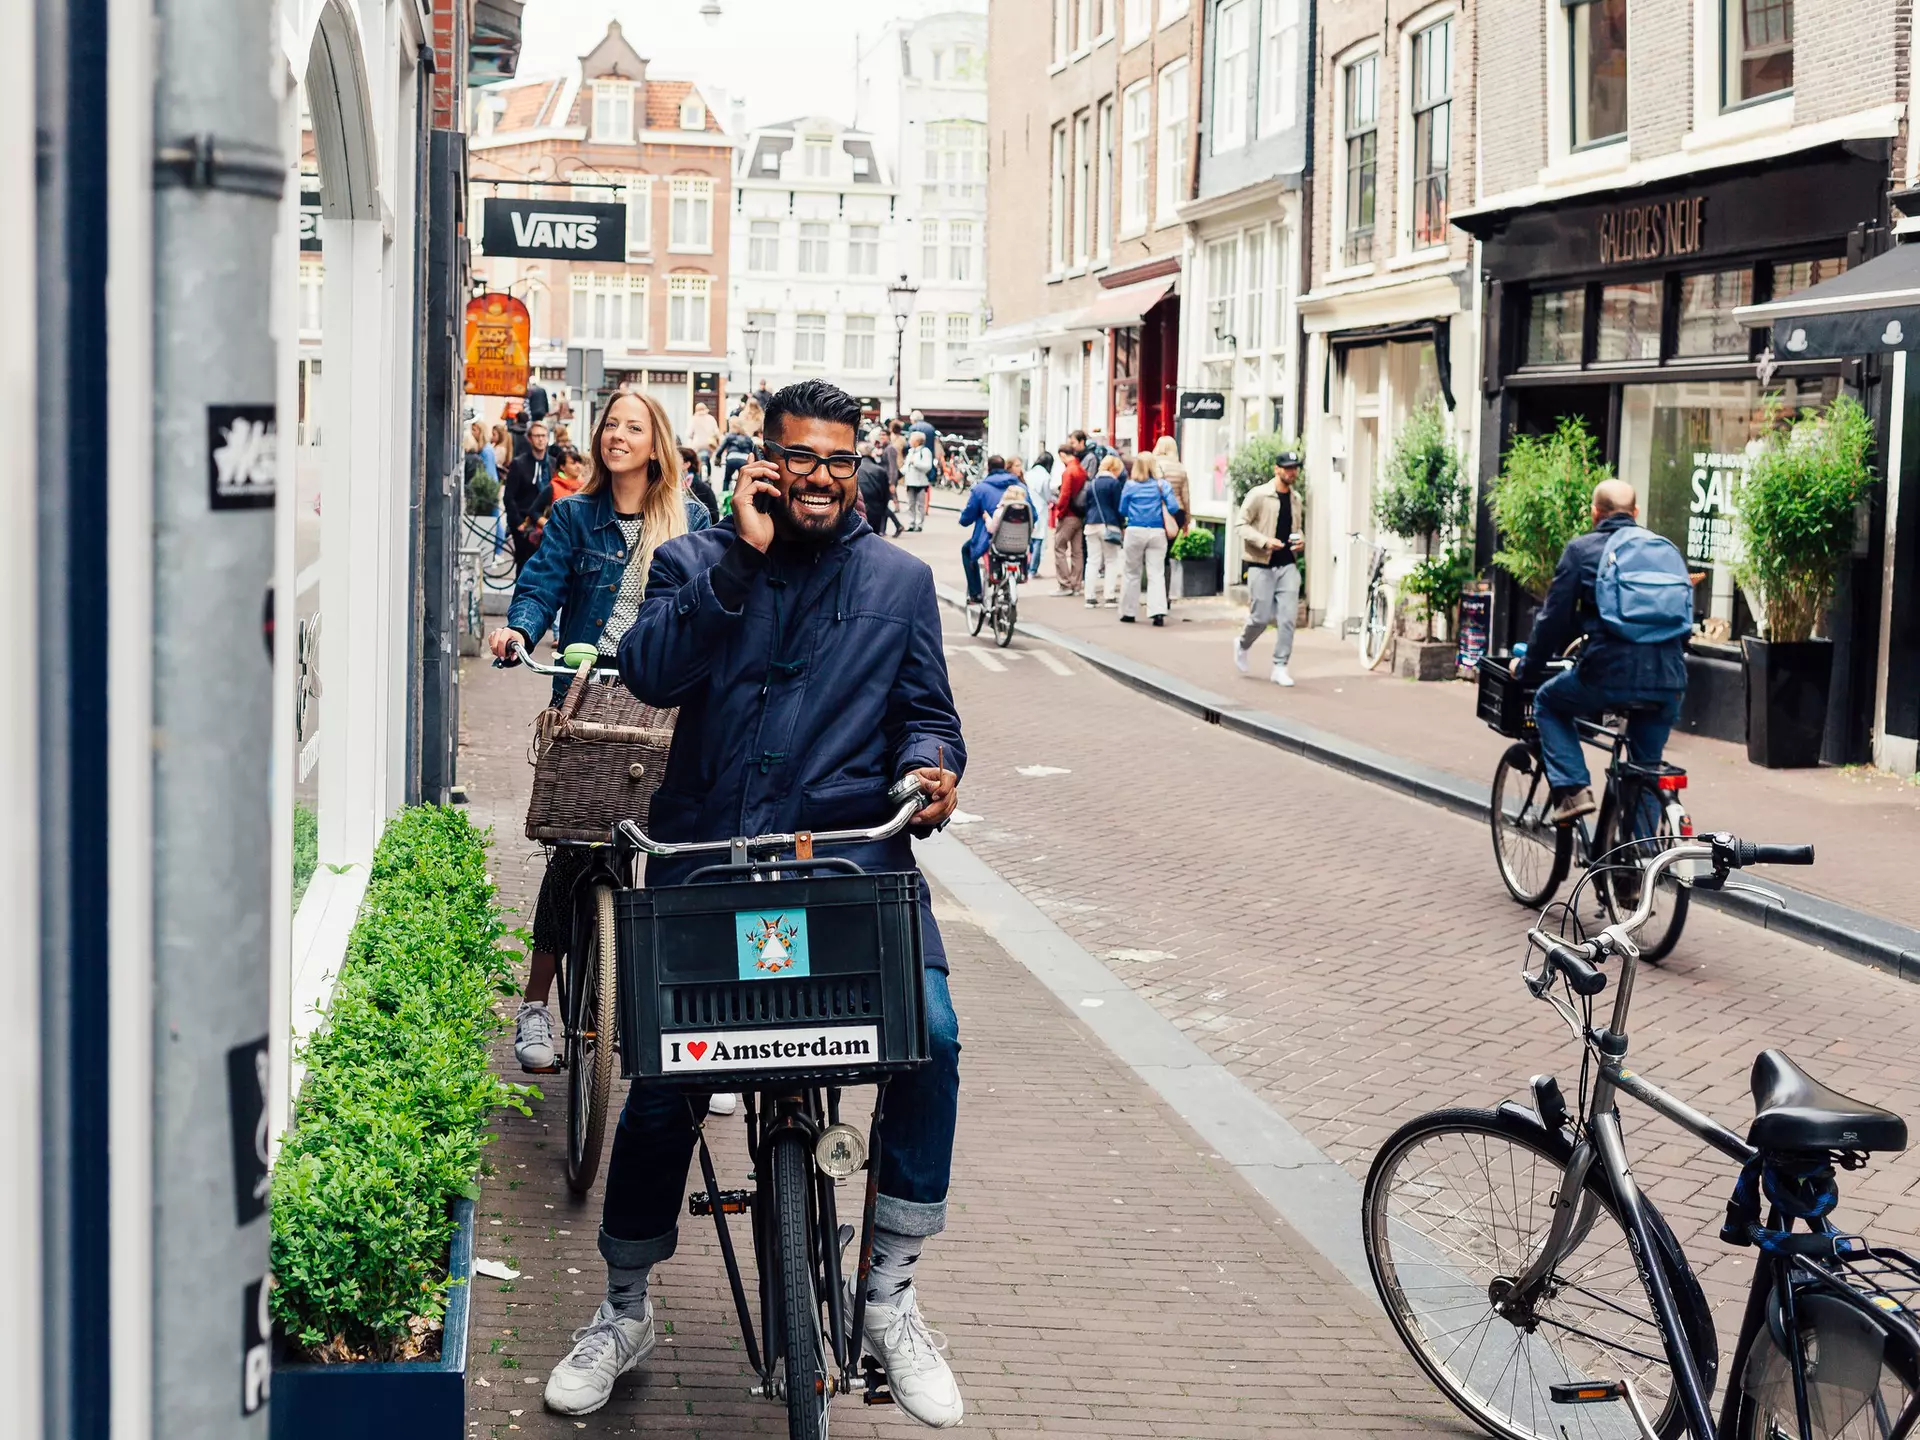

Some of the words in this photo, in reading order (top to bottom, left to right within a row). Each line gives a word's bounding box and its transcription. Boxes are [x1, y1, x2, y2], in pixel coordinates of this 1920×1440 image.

[510, 211, 598, 250] VANS
[1600, 204, 1662, 264] GALERIES
[1665, 196, 1703, 257] NEUF
[1693, 452, 1707, 467] WE
[1707, 453, 1721, 468] ARE
[1688, 516, 1705, 532] BUY
[1687, 529, 1704, 545] BUY
[1703, 531, 1710, 546] 2
[1686, 543, 1703, 558] BUY
[1702, 544, 1710, 559] 3
[670, 1042, 681, 1063] I
[710, 1036, 870, 1062] Amsterdam
